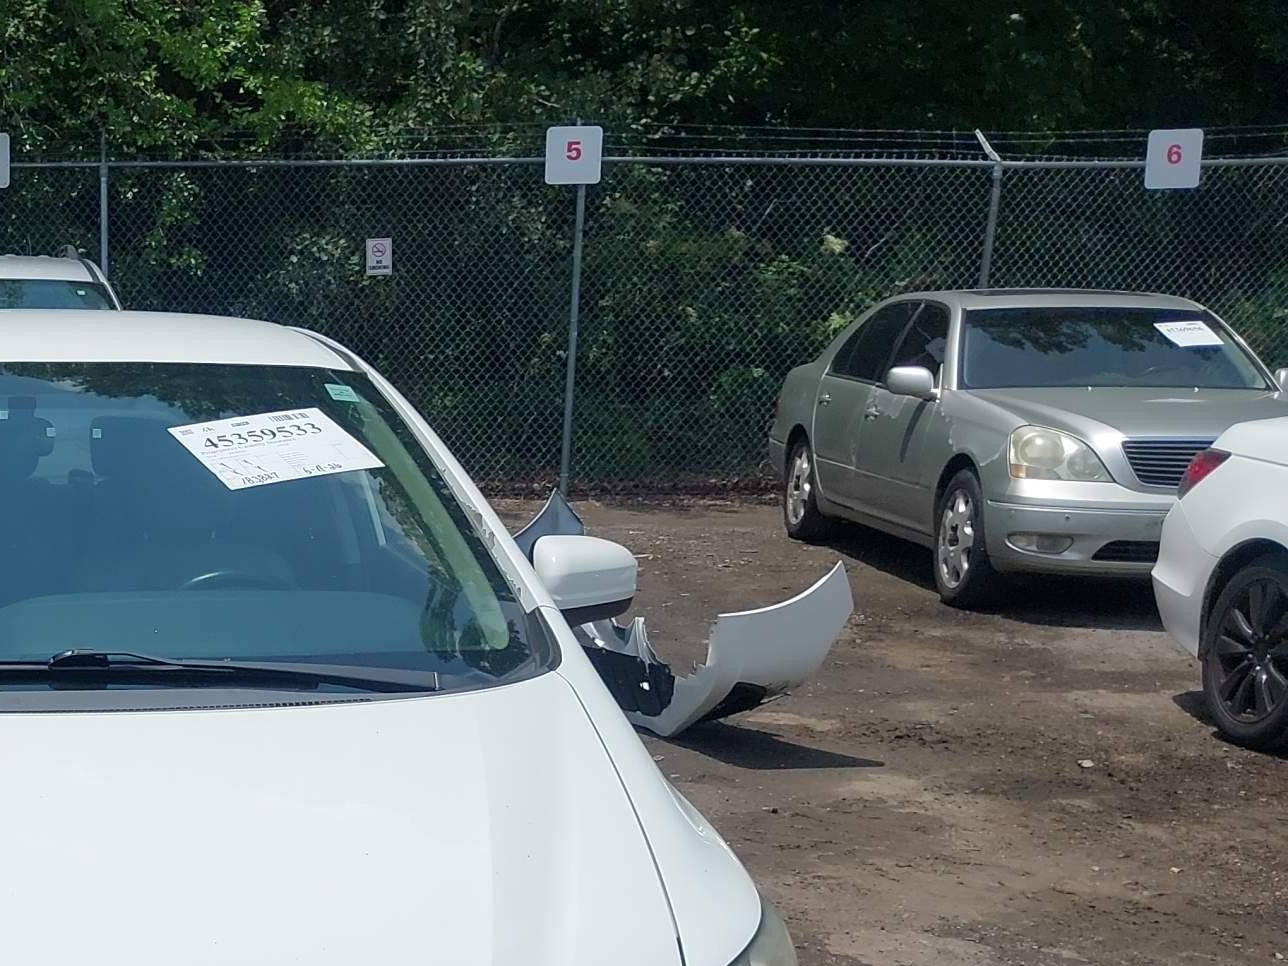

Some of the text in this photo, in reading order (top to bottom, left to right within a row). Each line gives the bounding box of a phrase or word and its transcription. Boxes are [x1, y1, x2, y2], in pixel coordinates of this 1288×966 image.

[565, 141, 582, 161] 5
[1166, 144, 1183, 165] 6
[203, 422, 323, 449] 45359533
